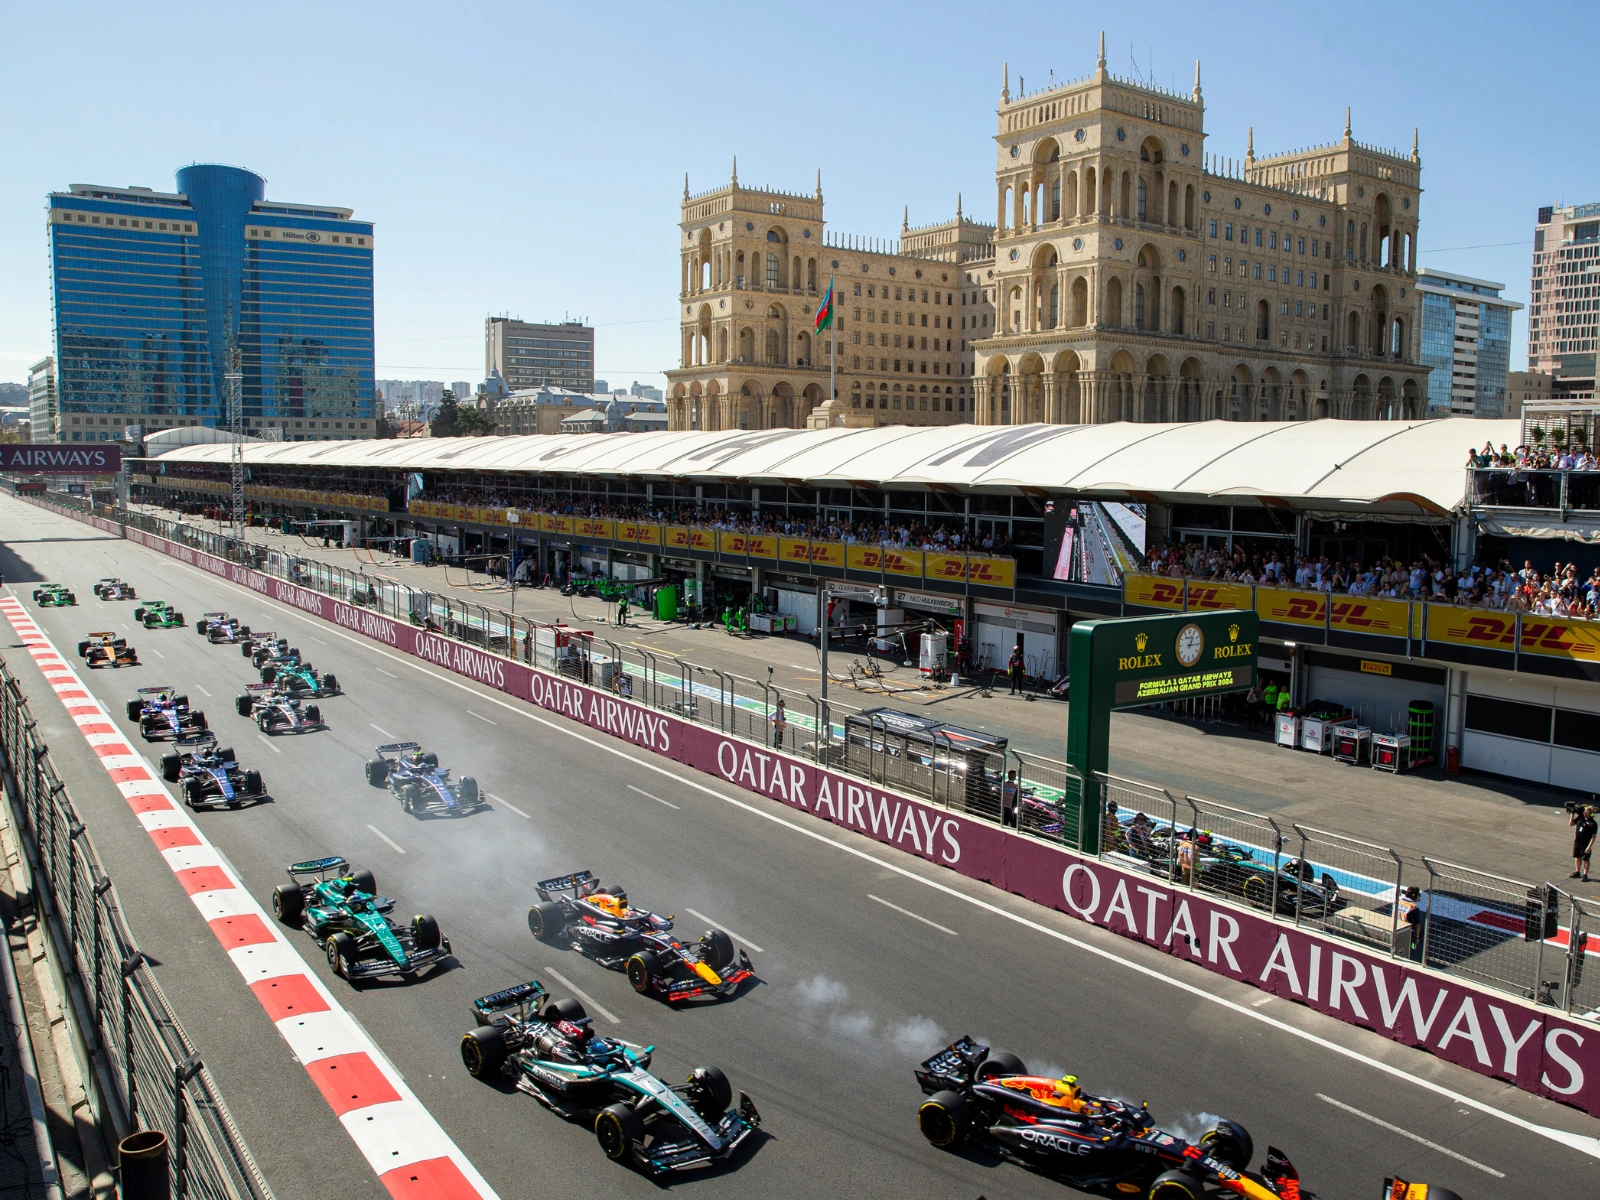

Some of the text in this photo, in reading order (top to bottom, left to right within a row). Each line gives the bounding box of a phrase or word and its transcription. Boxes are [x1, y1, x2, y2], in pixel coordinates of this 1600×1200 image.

[282, 232, 304, 240] Hilton
[11, 450, 106, 466] AIRWAYS
[436, 508, 451, 517] DHL
[460, 510, 477, 520] DHL
[486, 513, 504, 524] DHL
[547, 519, 566, 531] DHL
[583, 524, 604, 535] DHL
[626, 528, 652, 540] DHL
[676, 532, 704, 546] DHL
[733, 538, 764, 553] DHL
[792, 545, 829, 560] DHL
[863, 552, 906, 570] DHL
[232, 565, 267, 593] QATAR AIRWAYS
[944, 561, 994, 580] DHL
[276, 582, 322, 614] QATAR AIRWAYS
[1148, 584, 1222, 608] DHL
[1287, 598, 1372, 628] DHL
[334, 602, 396, 644] QATAR AIRWAYS
[1465, 617, 1573, 650] DHL
[415, 632, 505, 687] QATAR AIRWAYS
[1214, 644, 1252, 659] ROLEX
[1118, 654, 1162, 670] ROLEX
[1363, 662, 1389, 673] PIRELLI
[1137, 686, 1178, 698] AZERBAIJAN
[1179, 682, 1202, 692] GRAND
[1202, 680, 1217, 688] PRIX
[1140, 680, 1172, 690] FORMULA
[1178, 676, 1201, 685] QATAR
[1202, 671, 1232, 682] AIRWAYS
[532, 674, 584, 720] QATAR
[588, 694, 670, 752] AIRWAYS
[718, 740, 961, 864] QATAR AIRWAYS
[579, 926, 612, 944] ORACLE
[1062, 864, 1584, 1095] QATAR AIRWAYS
[483, 983, 531, 1003] PETRONAS
[532, 1066, 568, 1092] PETRONAS
[1020, 1129, 1092, 1157] ORACLE
[1135, 1142, 1158, 1156] BYBIT
